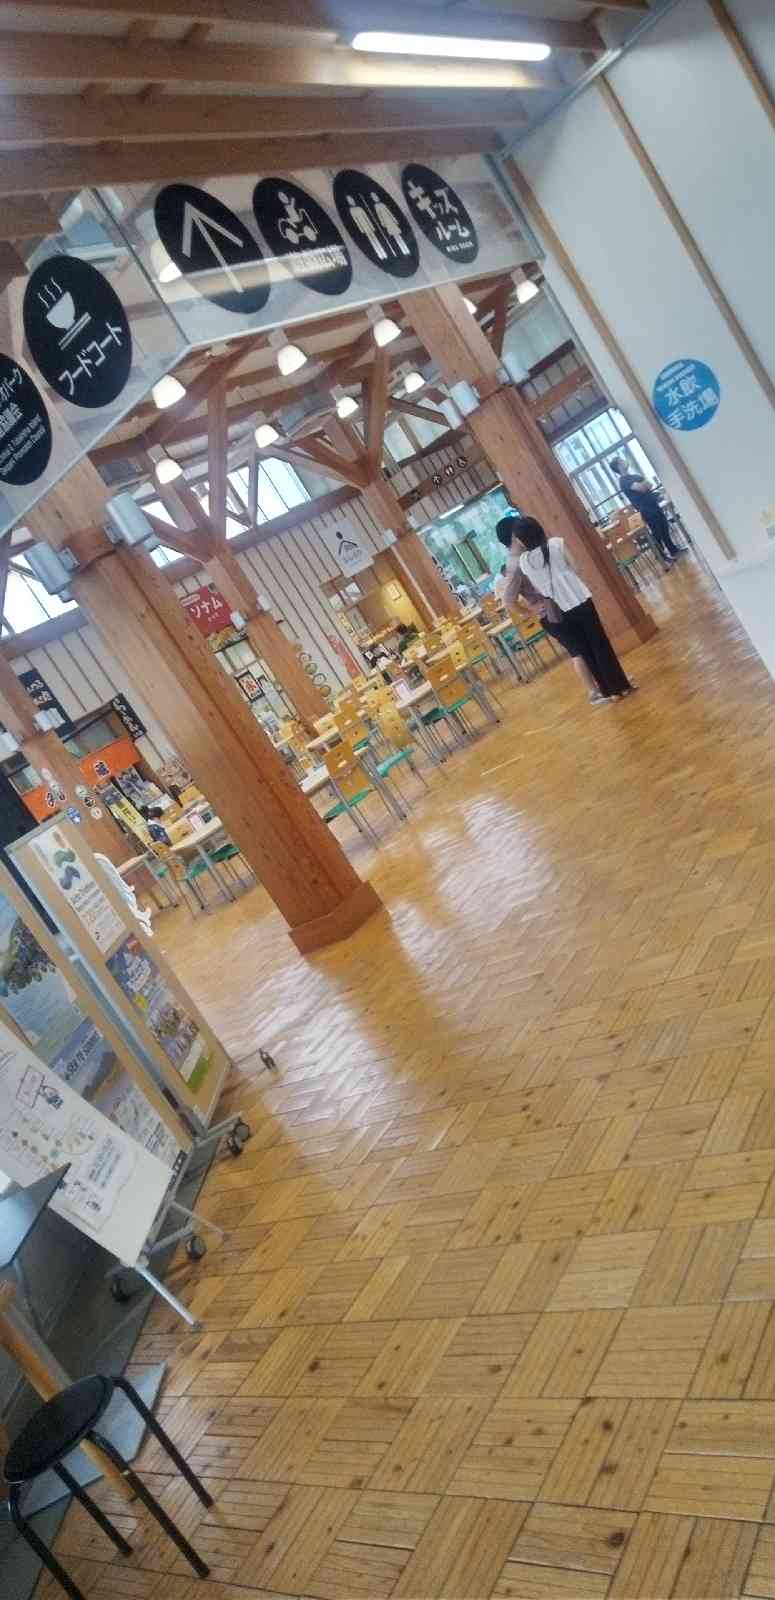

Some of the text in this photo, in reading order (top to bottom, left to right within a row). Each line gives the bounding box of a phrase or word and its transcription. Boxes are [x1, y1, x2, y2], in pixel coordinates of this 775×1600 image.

[408, 180, 459, 218] キッズ
[435, 219, 471, 240] ルーム
[58, 322, 122, 396] フードコート
